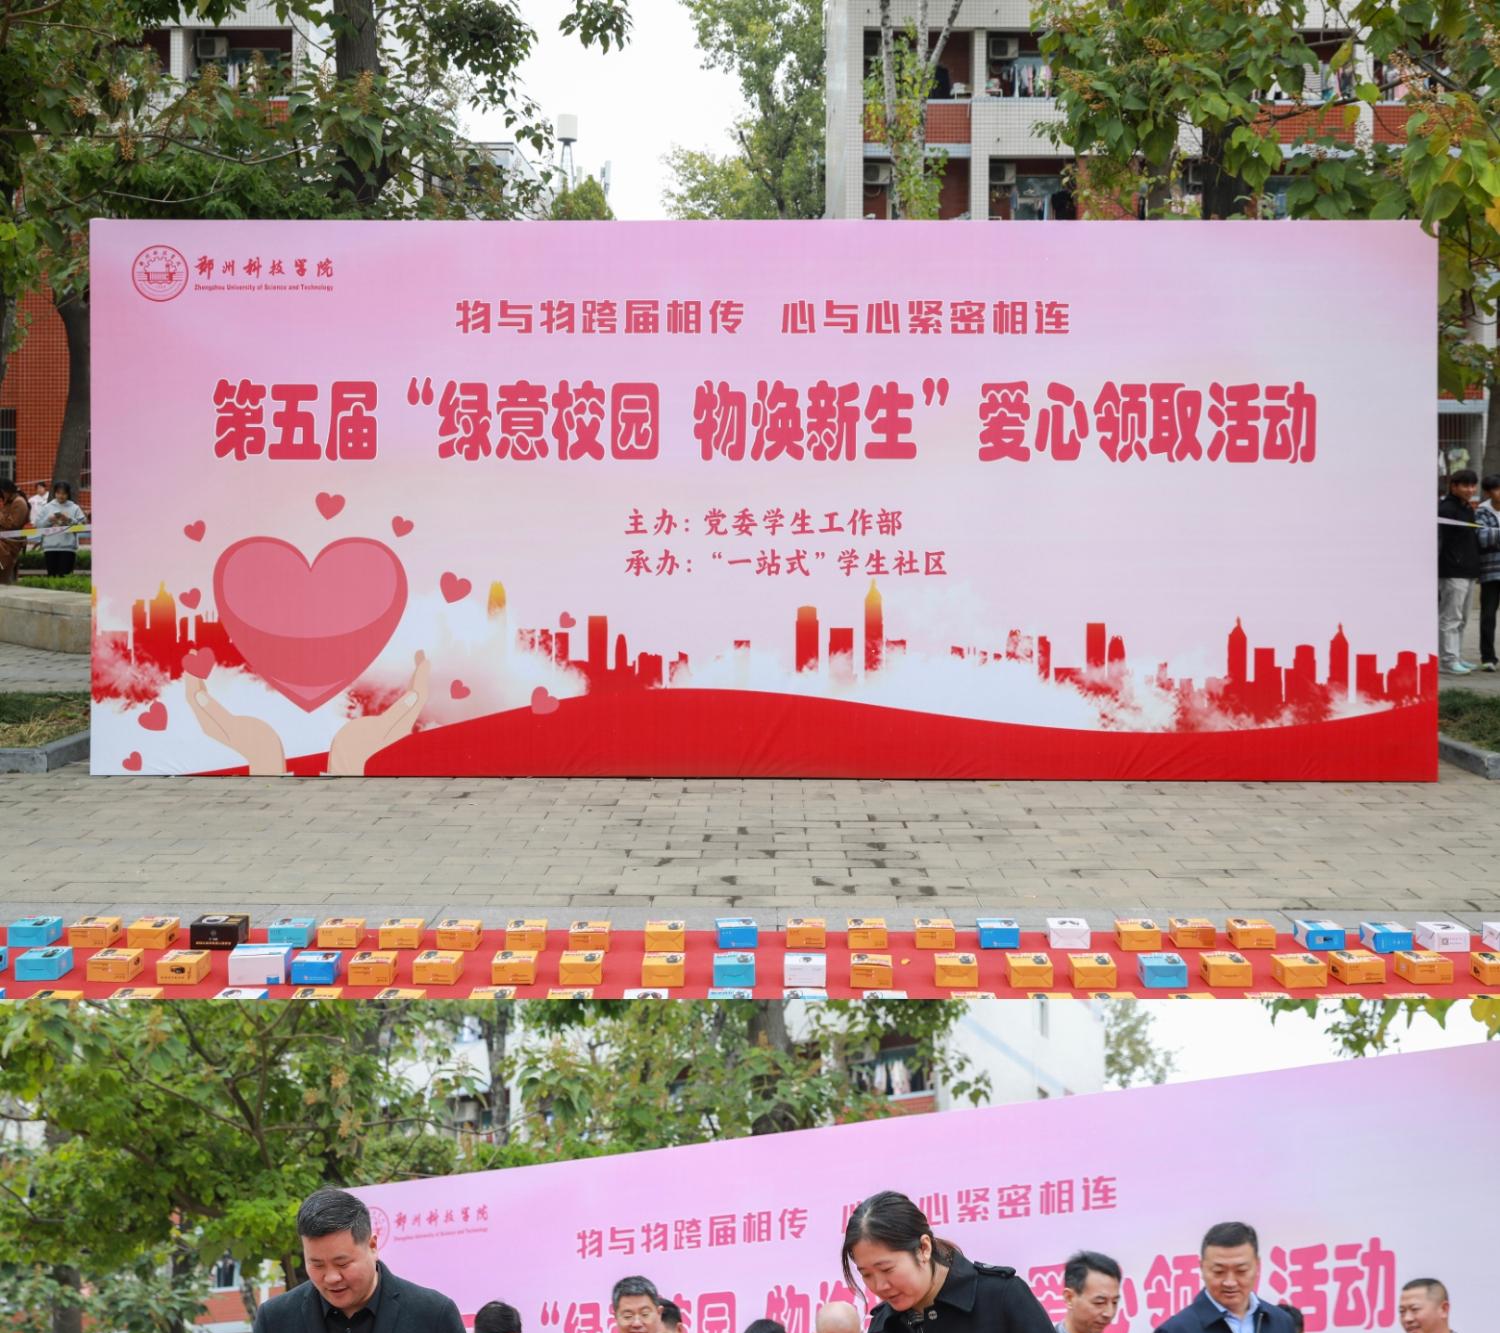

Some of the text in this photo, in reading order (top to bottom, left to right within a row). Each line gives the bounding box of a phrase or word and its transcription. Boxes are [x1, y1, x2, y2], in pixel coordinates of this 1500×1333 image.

[195, 255, 334, 279] 郑州科技学院
[227, 284, 255, 292] University
[456, 299, 1070, 335] 物与物跨届相传 心与心紧密相连
[576, 1208, 808, 1258] 物与物跨届相传
